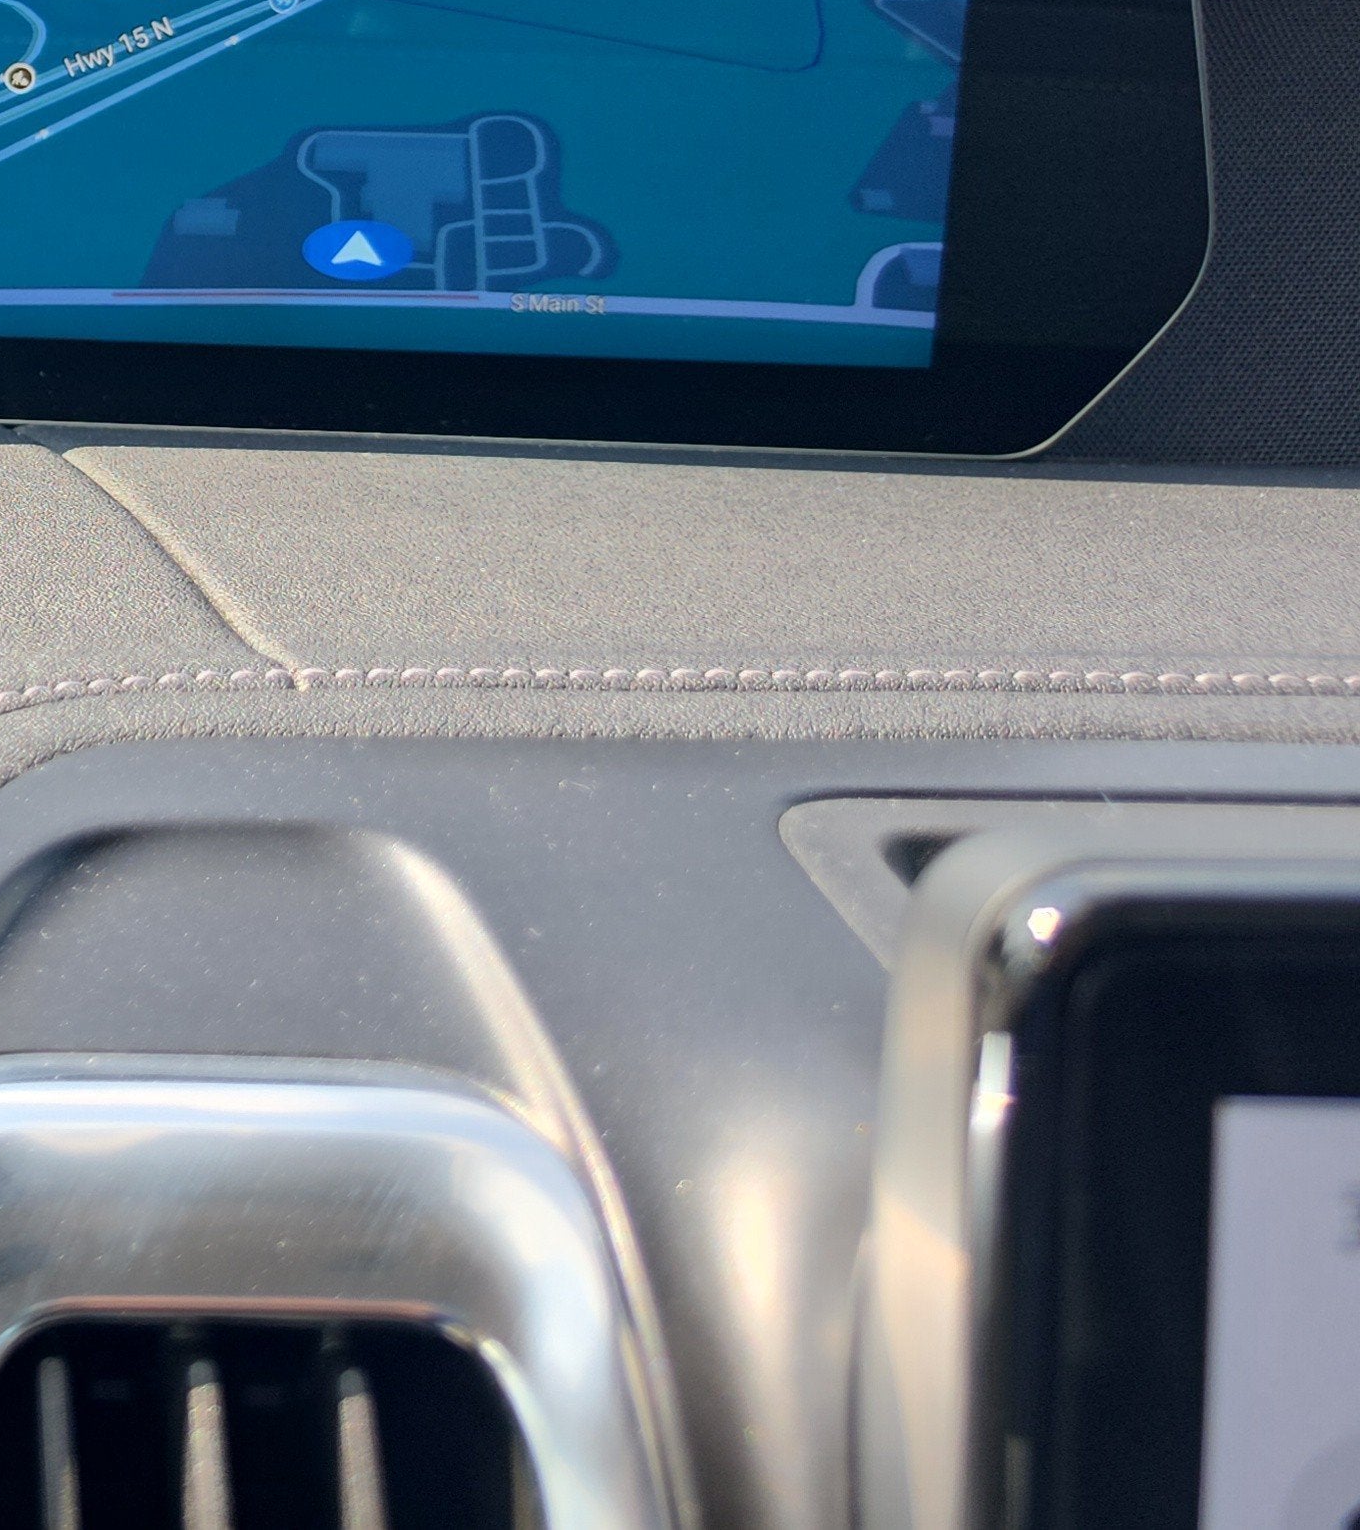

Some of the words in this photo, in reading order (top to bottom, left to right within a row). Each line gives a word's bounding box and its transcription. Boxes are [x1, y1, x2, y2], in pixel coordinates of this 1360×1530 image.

[64, 44, 114, 77] Hwy
[118, 26, 150, 53] 15
[150, 16, 174, 40] N
[510, 293, 525, 313] S
[529, 294, 580, 313] Main
[585, 295, 606, 315] St
